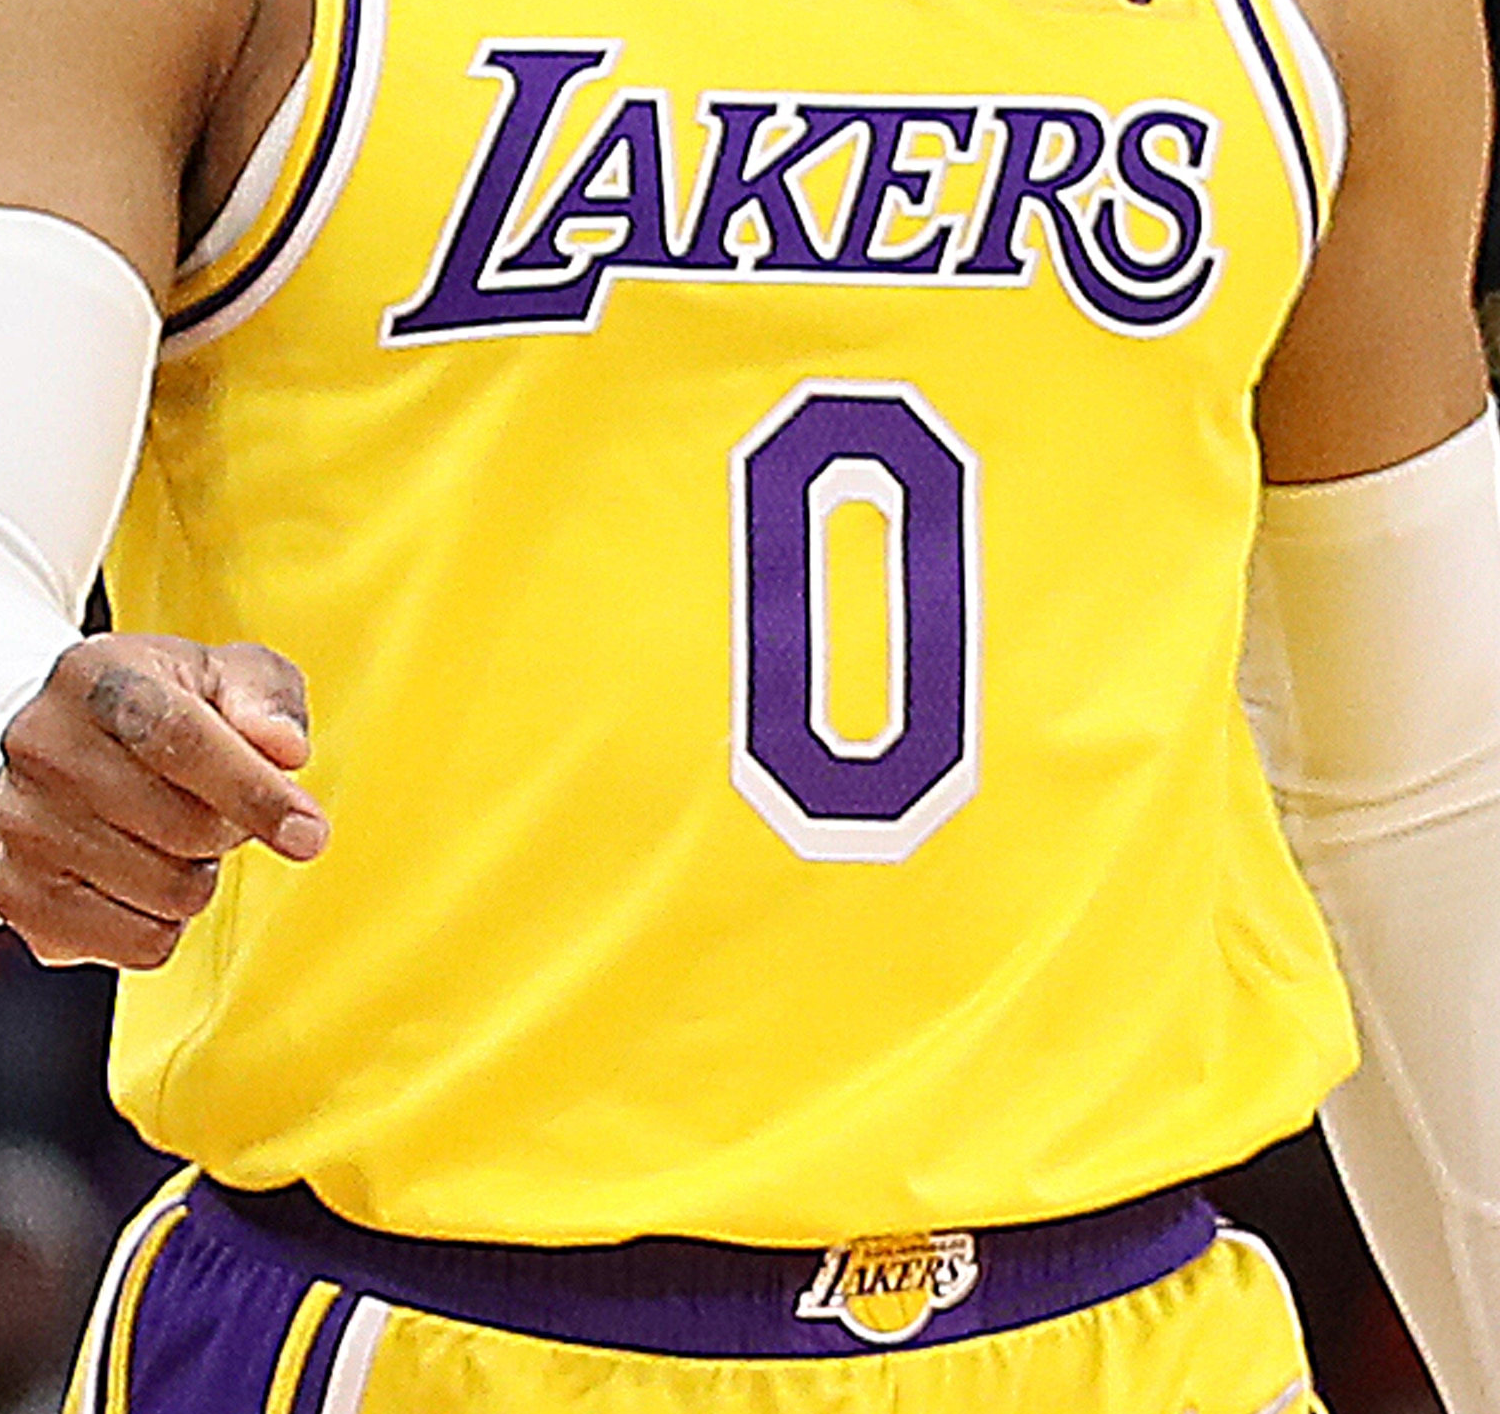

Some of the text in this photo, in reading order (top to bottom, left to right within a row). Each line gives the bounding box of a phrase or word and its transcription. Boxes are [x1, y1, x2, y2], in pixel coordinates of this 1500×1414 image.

[383, 41, 1222, 343] LAKERS
[732, 381, 979, 861] 0
[800, 1245, 973, 1311] LAKERS
